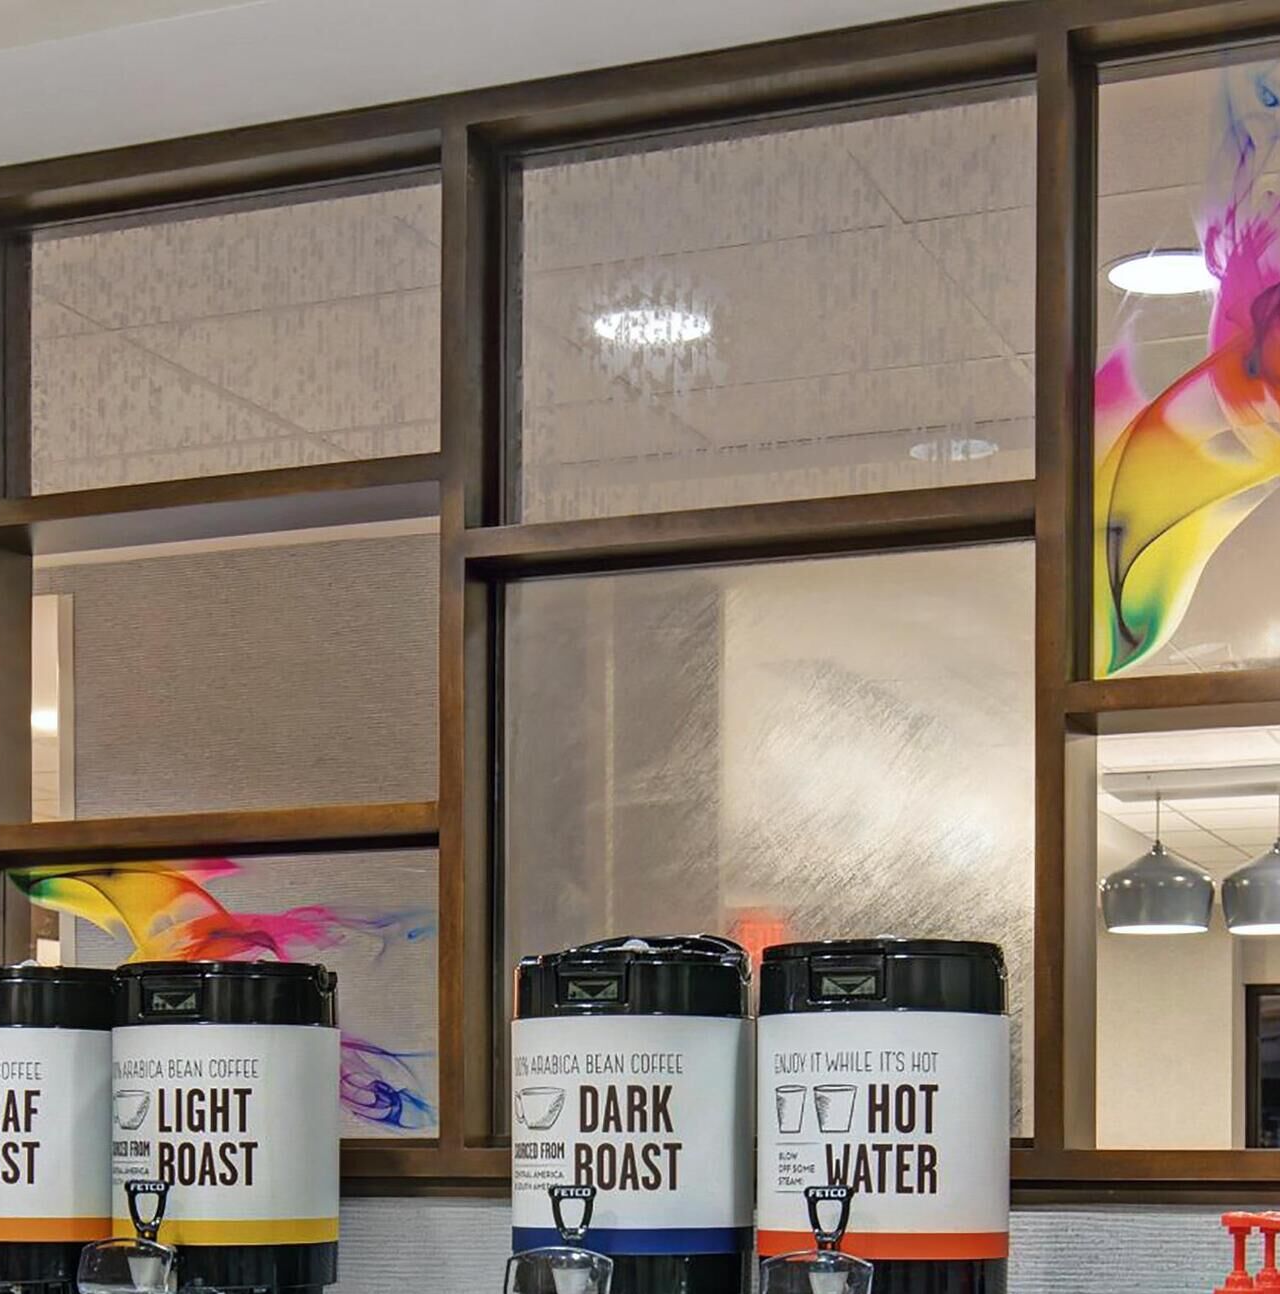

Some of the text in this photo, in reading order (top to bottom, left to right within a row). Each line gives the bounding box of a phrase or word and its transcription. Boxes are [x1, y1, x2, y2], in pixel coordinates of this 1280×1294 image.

[123, 1060, 163, 1080] ARABICA
[168, 1059, 202, 1078] BEAN
[208, 1059, 259, 1079] COFFEE
[531, 1053, 580, 1076] ARABICA
[586, 1053, 624, 1075] BEAN
[630, 1053, 684, 1074] COFFEE
[775, 1051, 939, 1074] ENJOY IT WHILE IT'S HOT
[158, 1088, 253, 1133] LIGHT
[580, 1085, 674, 1133] DARK
[868, 1084, 939, 1134] HOT
[157, 1141, 259, 1186] ROAST
[541, 1142, 565, 1160] FROM
[574, 1143, 683, 1191] ROAST
[825, 1143, 938, 1194] WATER
[554, 1188, 592, 1197] FETCO
[809, 1188, 847, 1197] FETCO
